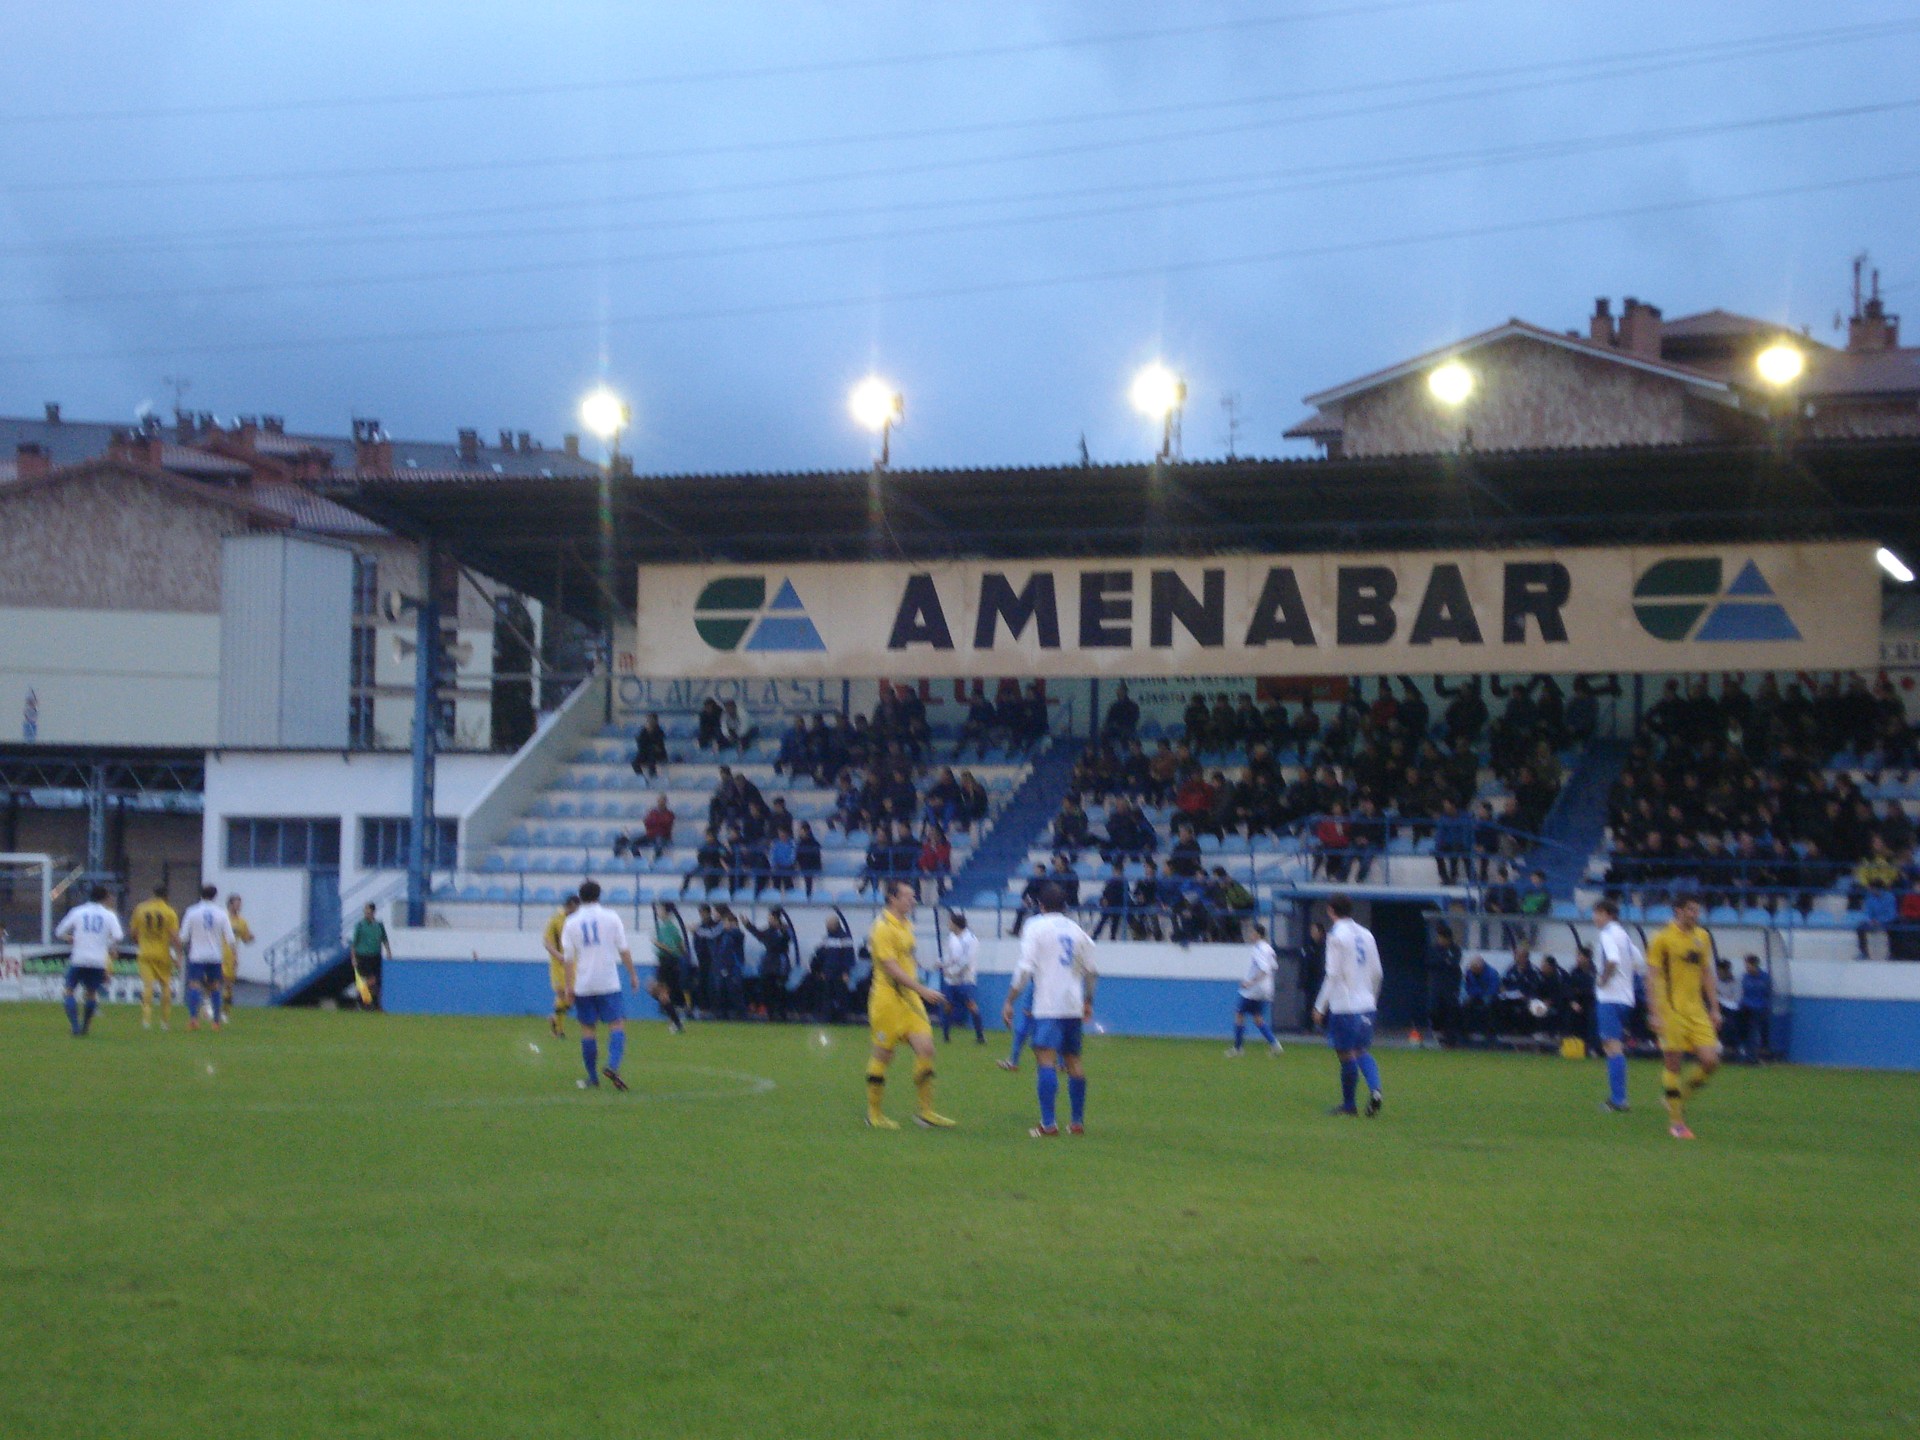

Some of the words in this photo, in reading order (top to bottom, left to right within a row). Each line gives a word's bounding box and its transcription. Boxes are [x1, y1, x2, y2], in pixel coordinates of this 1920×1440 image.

[886, 561, 1571, 650] AMENABAR
[581, 919, 600, 947] 11
[1058, 935, 1074, 967] 3
[1355, 935, 1367, 965] 5
